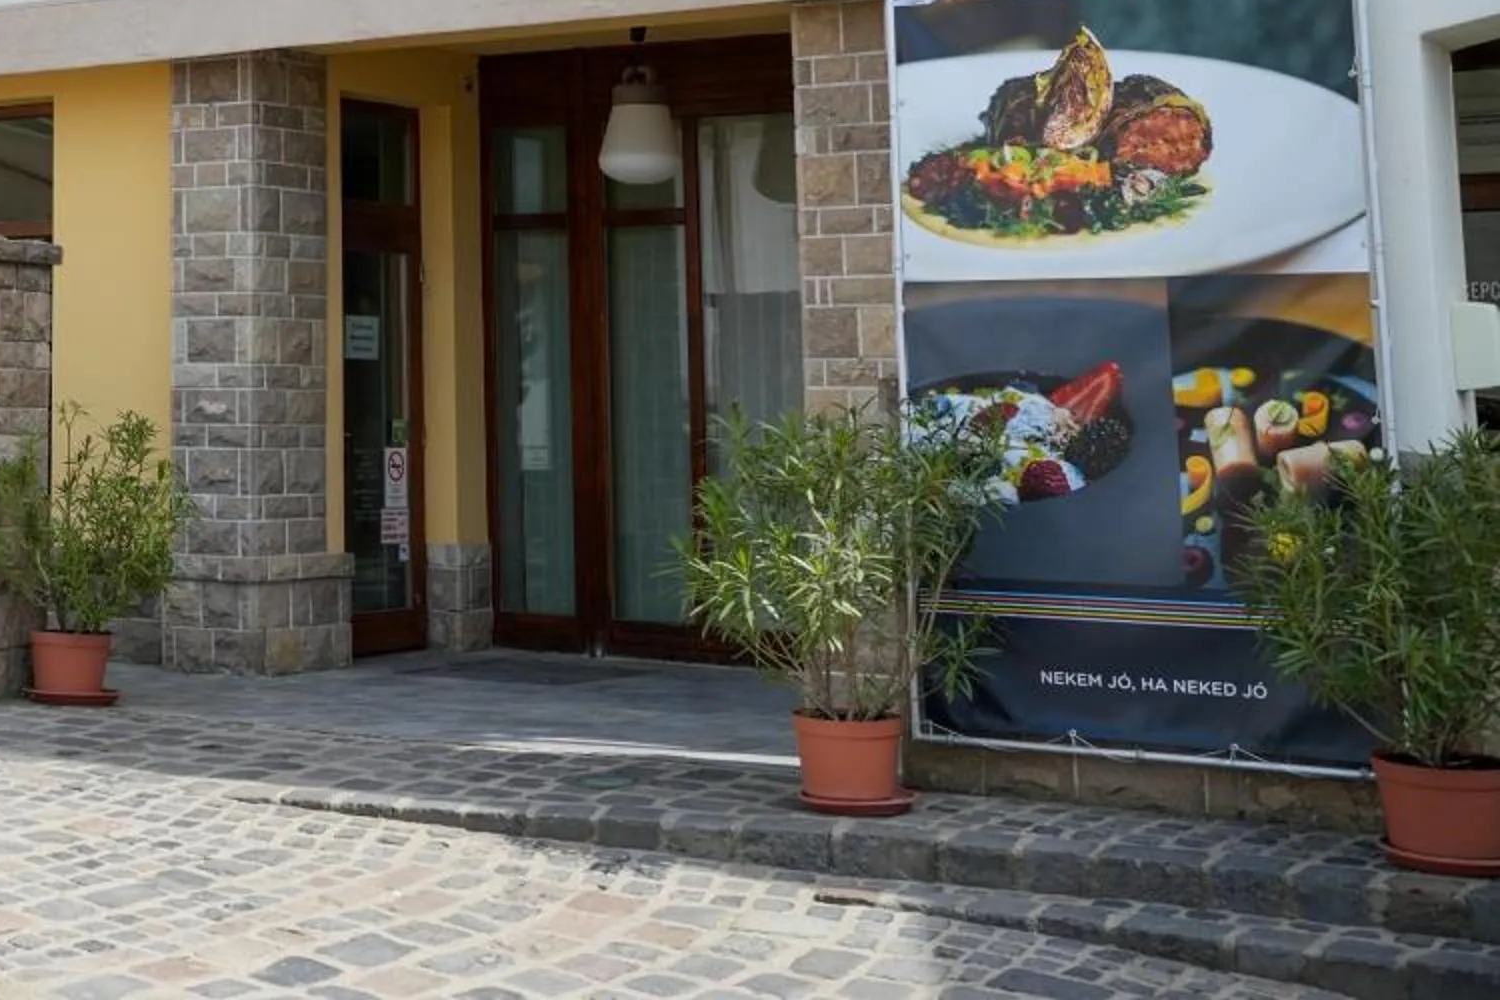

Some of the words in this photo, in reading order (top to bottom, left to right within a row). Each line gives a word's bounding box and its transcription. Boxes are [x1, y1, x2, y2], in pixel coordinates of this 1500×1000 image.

[1464, 281, 1500, 300] EPC
[1040, 670, 1102, 688] NEKEM
[1107, 673, 1136, 692] JÓ,
[1141, 677, 1167, 692] HA
[1173, 679, 1237, 697] NEKED
[1243, 681, 1268, 699] JÓ
